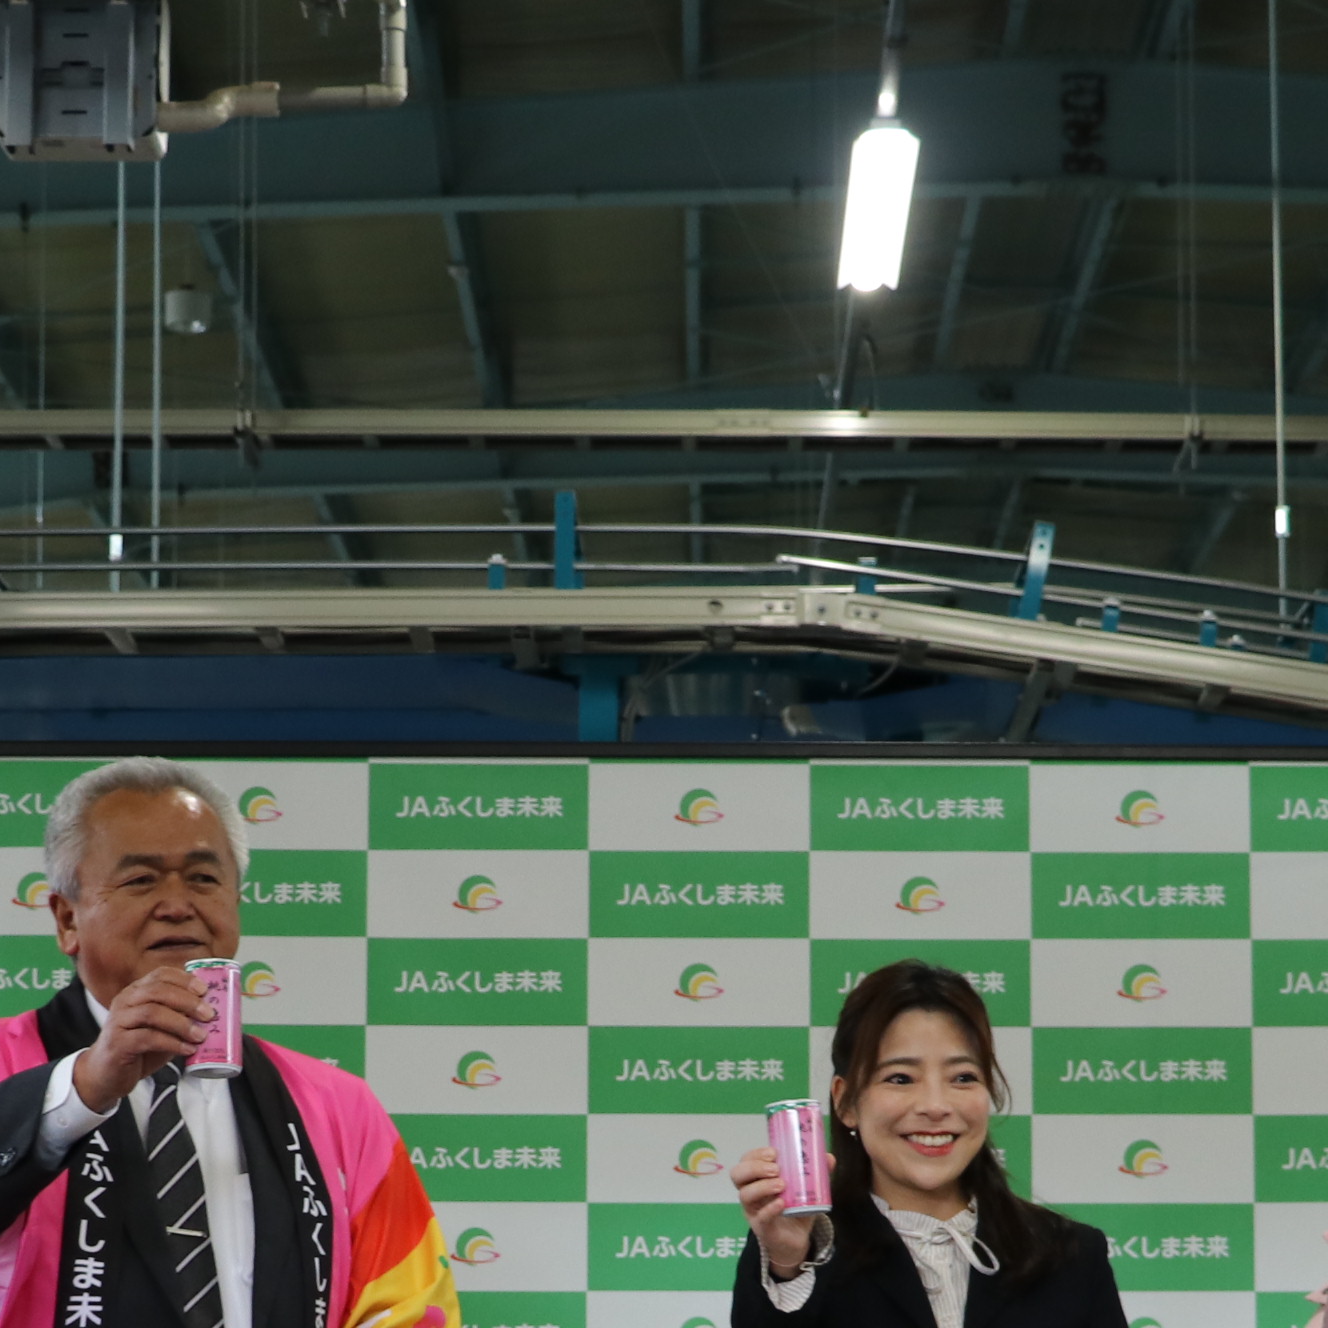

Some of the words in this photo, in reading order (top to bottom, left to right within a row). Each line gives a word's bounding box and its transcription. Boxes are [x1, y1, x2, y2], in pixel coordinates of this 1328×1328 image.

[397, 796, 564, 819] JAふくしま未来
[838, 798, 1005, 821] JAふくしま未来
[239, 881, 342, 904] くしま未来
[617, 883, 785, 907] JAふくしま未来
[1059, 885, 1227, 908] JAふくしま未来
[395, 971, 563, 994] JAふくしま未来
[616, 1059, 785, 1083] JAふくしま未来
[1060, 1060, 1228, 1084] JAふくしま未来
[410, 1146, 562, 1169] Aふくしま未来
[616, 1236, 747, 1260] JAふくしま
[1106, 1236, 1230, 1259] ふくしま未来
